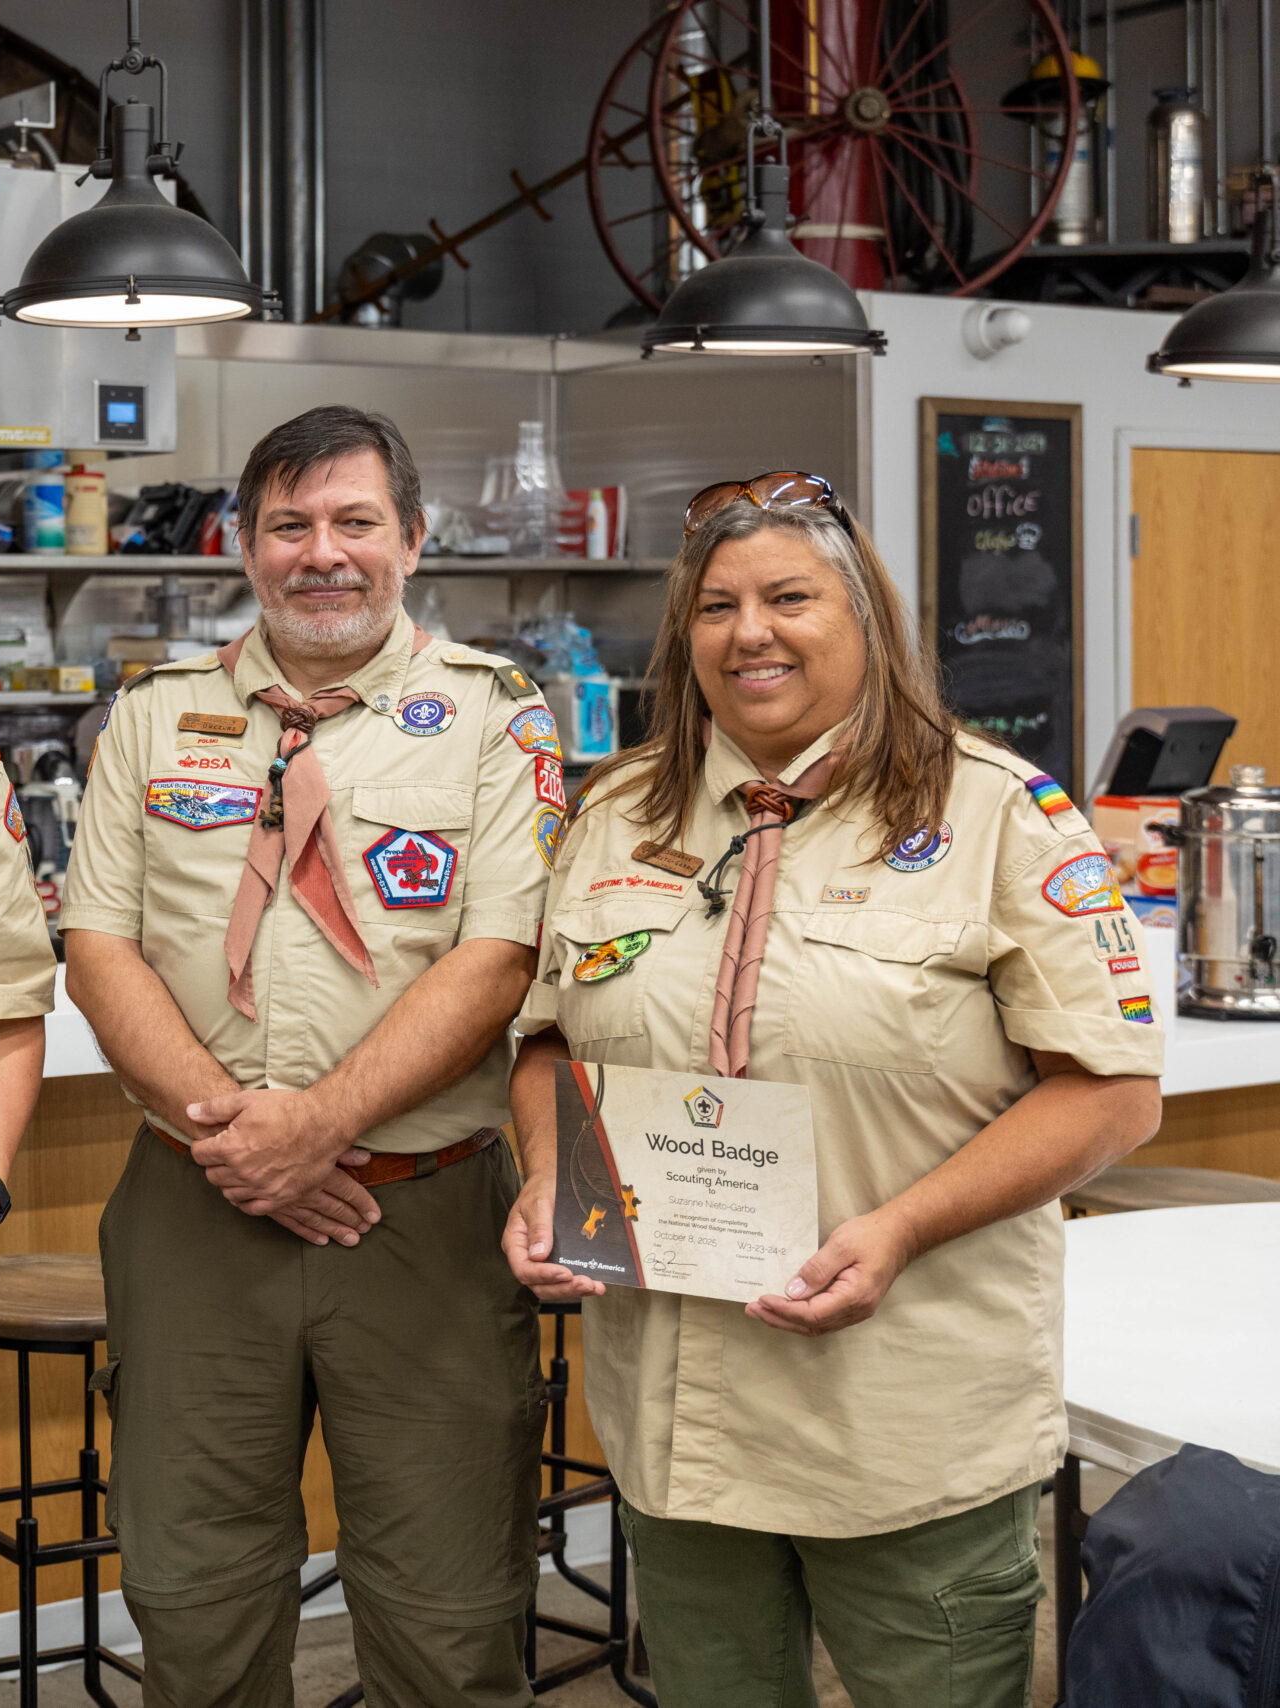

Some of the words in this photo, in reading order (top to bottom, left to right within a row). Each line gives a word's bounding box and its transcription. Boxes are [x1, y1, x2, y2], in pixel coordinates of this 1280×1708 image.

[199, 757, 232, 770] BSA
[174, 782, 197, 790] BUENA
[198, 784, 222, 793] LODGE
[1049, 864, 1078, 891] GOLDEN
[1077, 857, 1096, 871] GATE
[589, 878, 624, 893] SCOUTING
[642, 881, 684, 892] AMERICA
[1094, 916, 1136, 954] 415
[1122, 1001, 1151, 1020] Trained
[645, 1132, 704, 1157] Wood
[712, 1140, 779, 1168] Badge
[697, 1166, 716, 1175] given
[717, 1167, 727, 1177] by
[666, 1171, 712, 1188] Scouting
[715, 1177, 759, 1191] America
[708, 1187, 716, 1195] to
[668, 1195, 704, 1208] Suzanne
[705, 1199, 756, 1214] Nieto-Garbo
[668, 1220, 691, 1228] National
[708, 1225, 726, 1233] Badge
[726, 1228, 764, 1237] requirements
[679, 1213, 710, 1222] recognition
[717, 1218, 748, 1228] completing
[653, 1230, 686, 1242] October
[687, 1234, 696, 1244] 8,
[697, 1236, 718, 1248] 2025
[558, 1257, 588, 1269] Scouting
[597, 1262, 626, 1273] America
